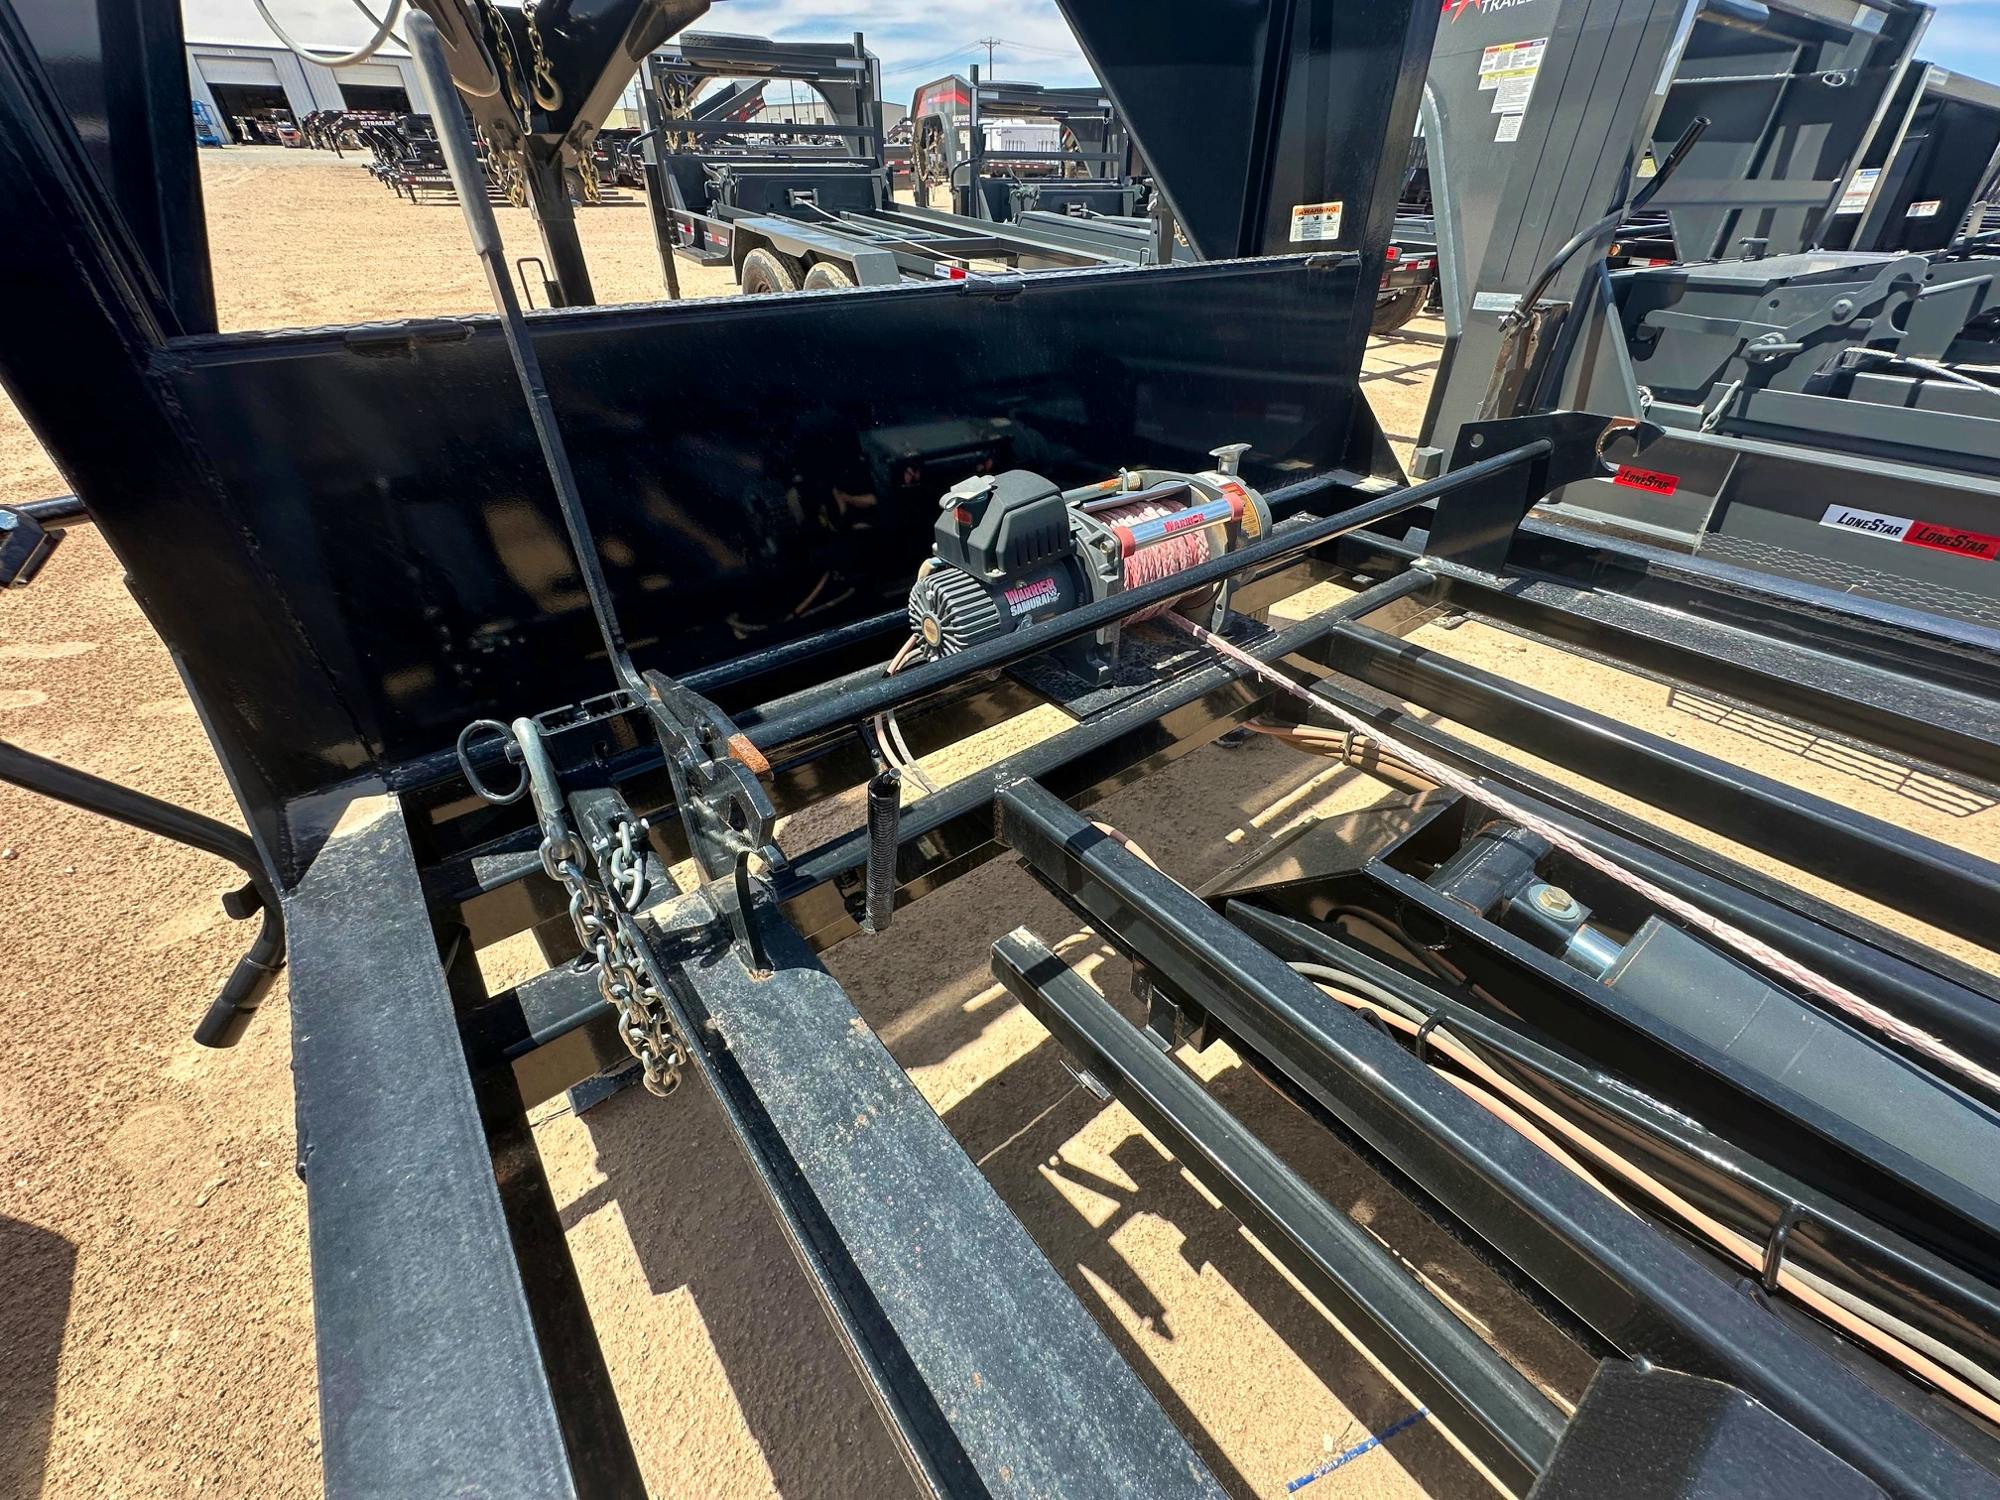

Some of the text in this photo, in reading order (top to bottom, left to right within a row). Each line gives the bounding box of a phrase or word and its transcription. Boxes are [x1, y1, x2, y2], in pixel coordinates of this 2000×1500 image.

[1163, 512, 1206, 534] WARRIOR
[1003, 576, 1056, 606] WARRIOR
[1009, 591, 1051, 617] SAMURAI
